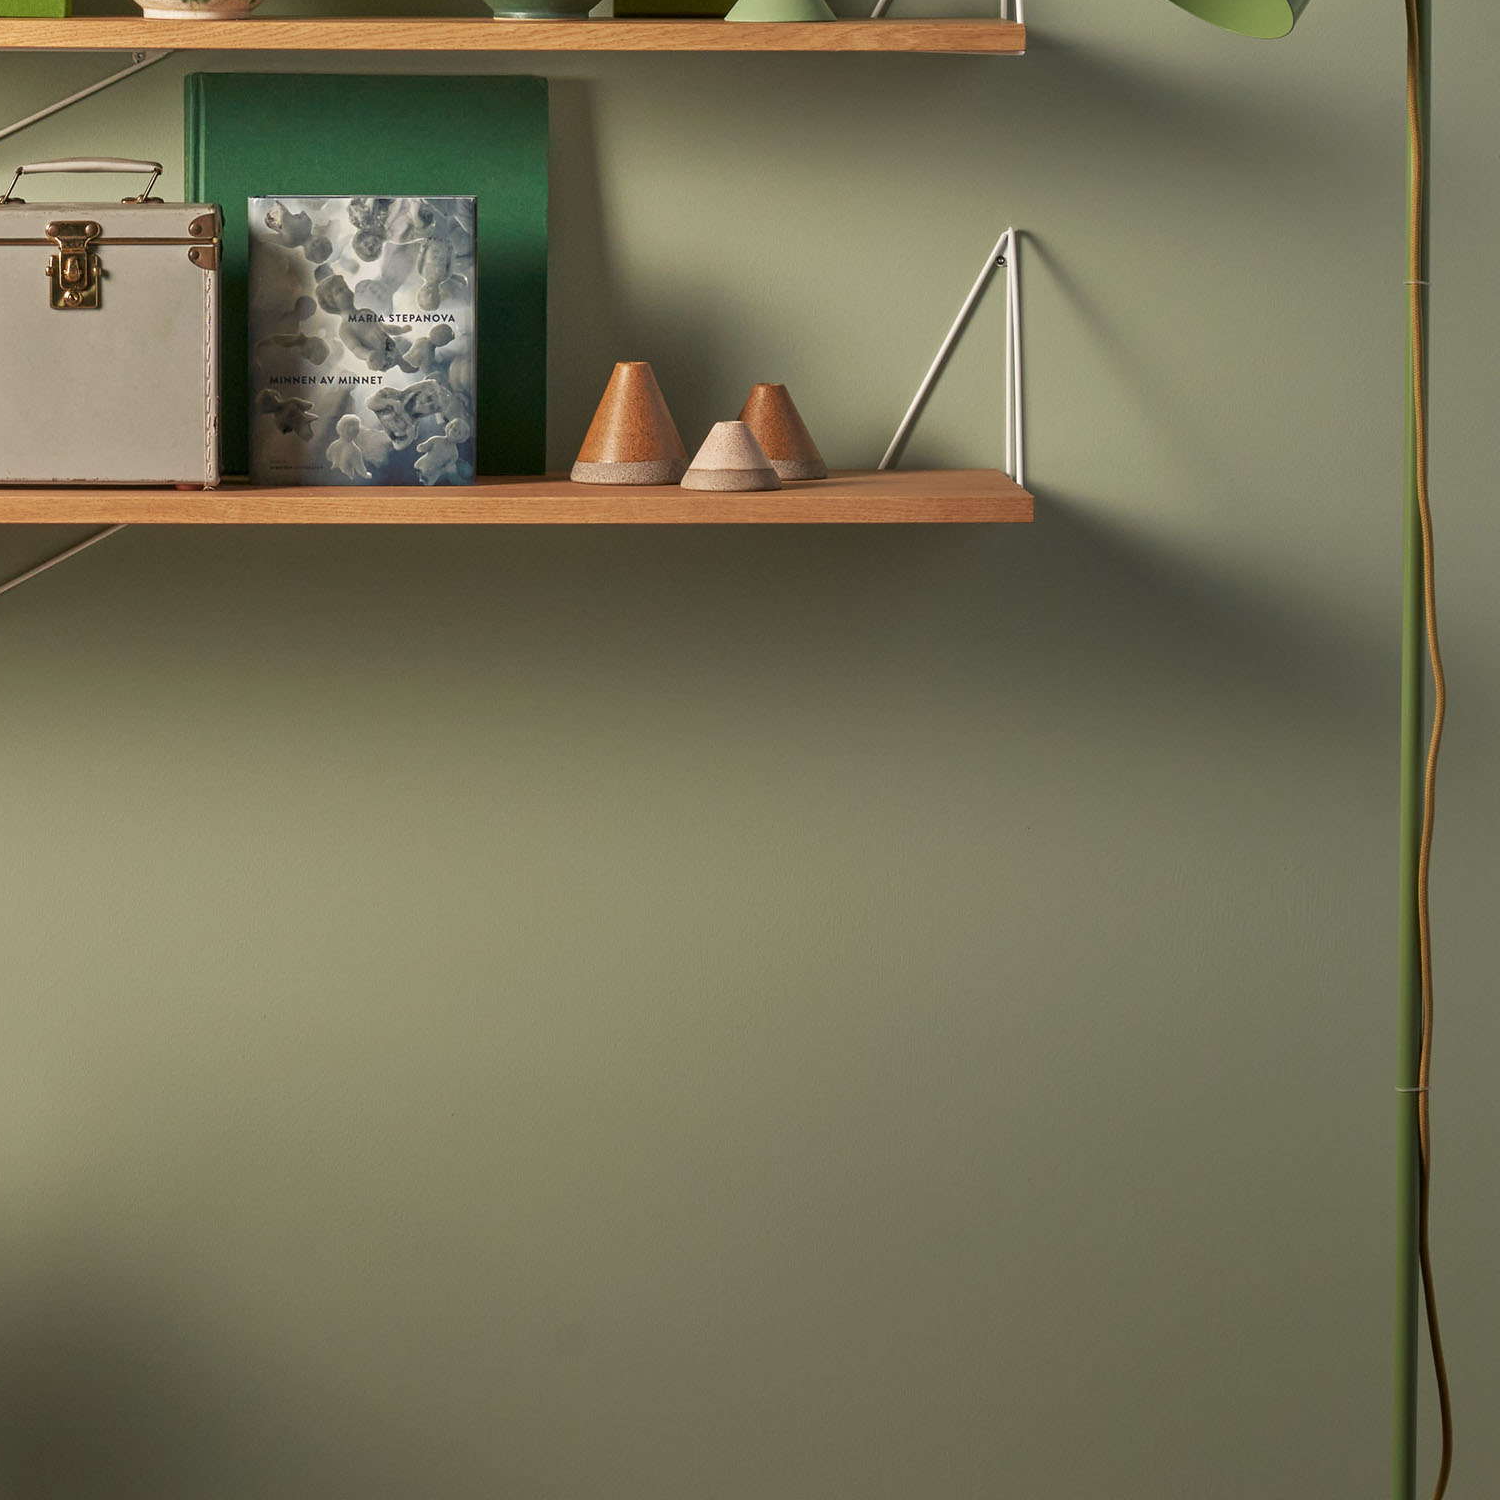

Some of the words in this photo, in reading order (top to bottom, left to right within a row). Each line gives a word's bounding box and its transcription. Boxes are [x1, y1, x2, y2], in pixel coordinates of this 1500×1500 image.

[348, 314, 385, 323] MARIA
[389, 314, 456, 323] STEPANOVA
[269, 376, 316, 385] MINNEN
[320, 376, 334, 385] AV
[338, 376, 383, 385] MINNET
